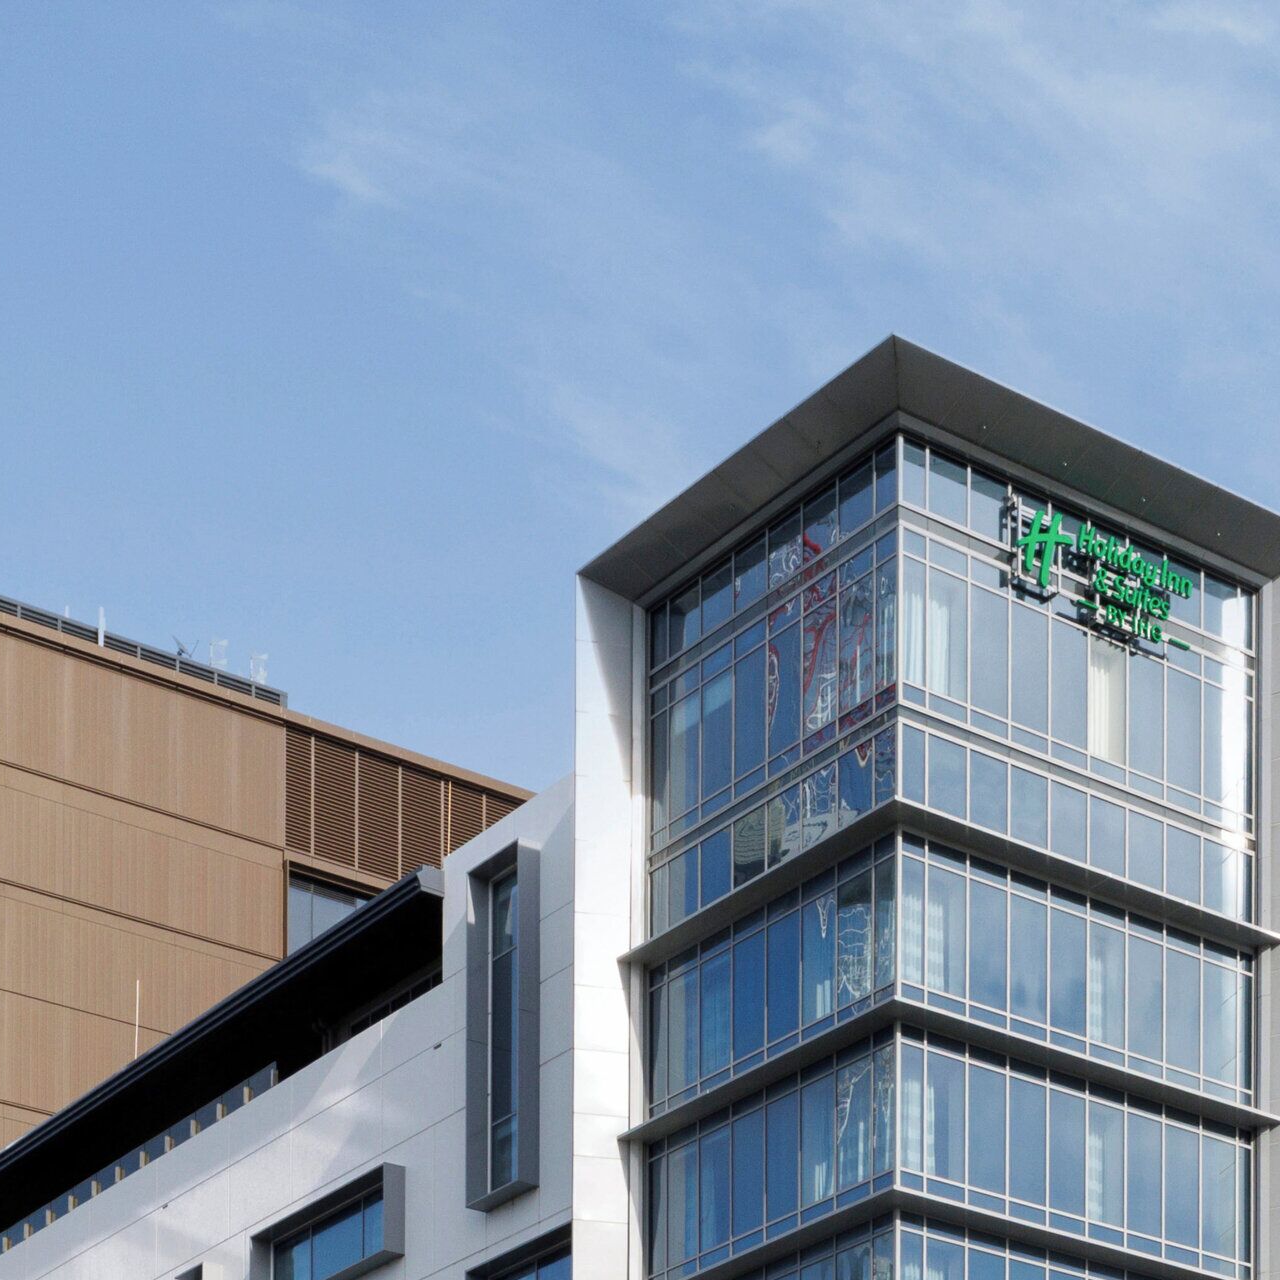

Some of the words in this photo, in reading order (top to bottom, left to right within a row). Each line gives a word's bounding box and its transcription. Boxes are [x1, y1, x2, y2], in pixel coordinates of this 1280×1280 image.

[1078, 522, 1158, 586] Holiday
[1160, 558, 1193, 599] Inn
[1094, 567, 1107, 592] &
[1111, 575, 1169, 620] Suites
[1106, 604, 1127, 628] BY
